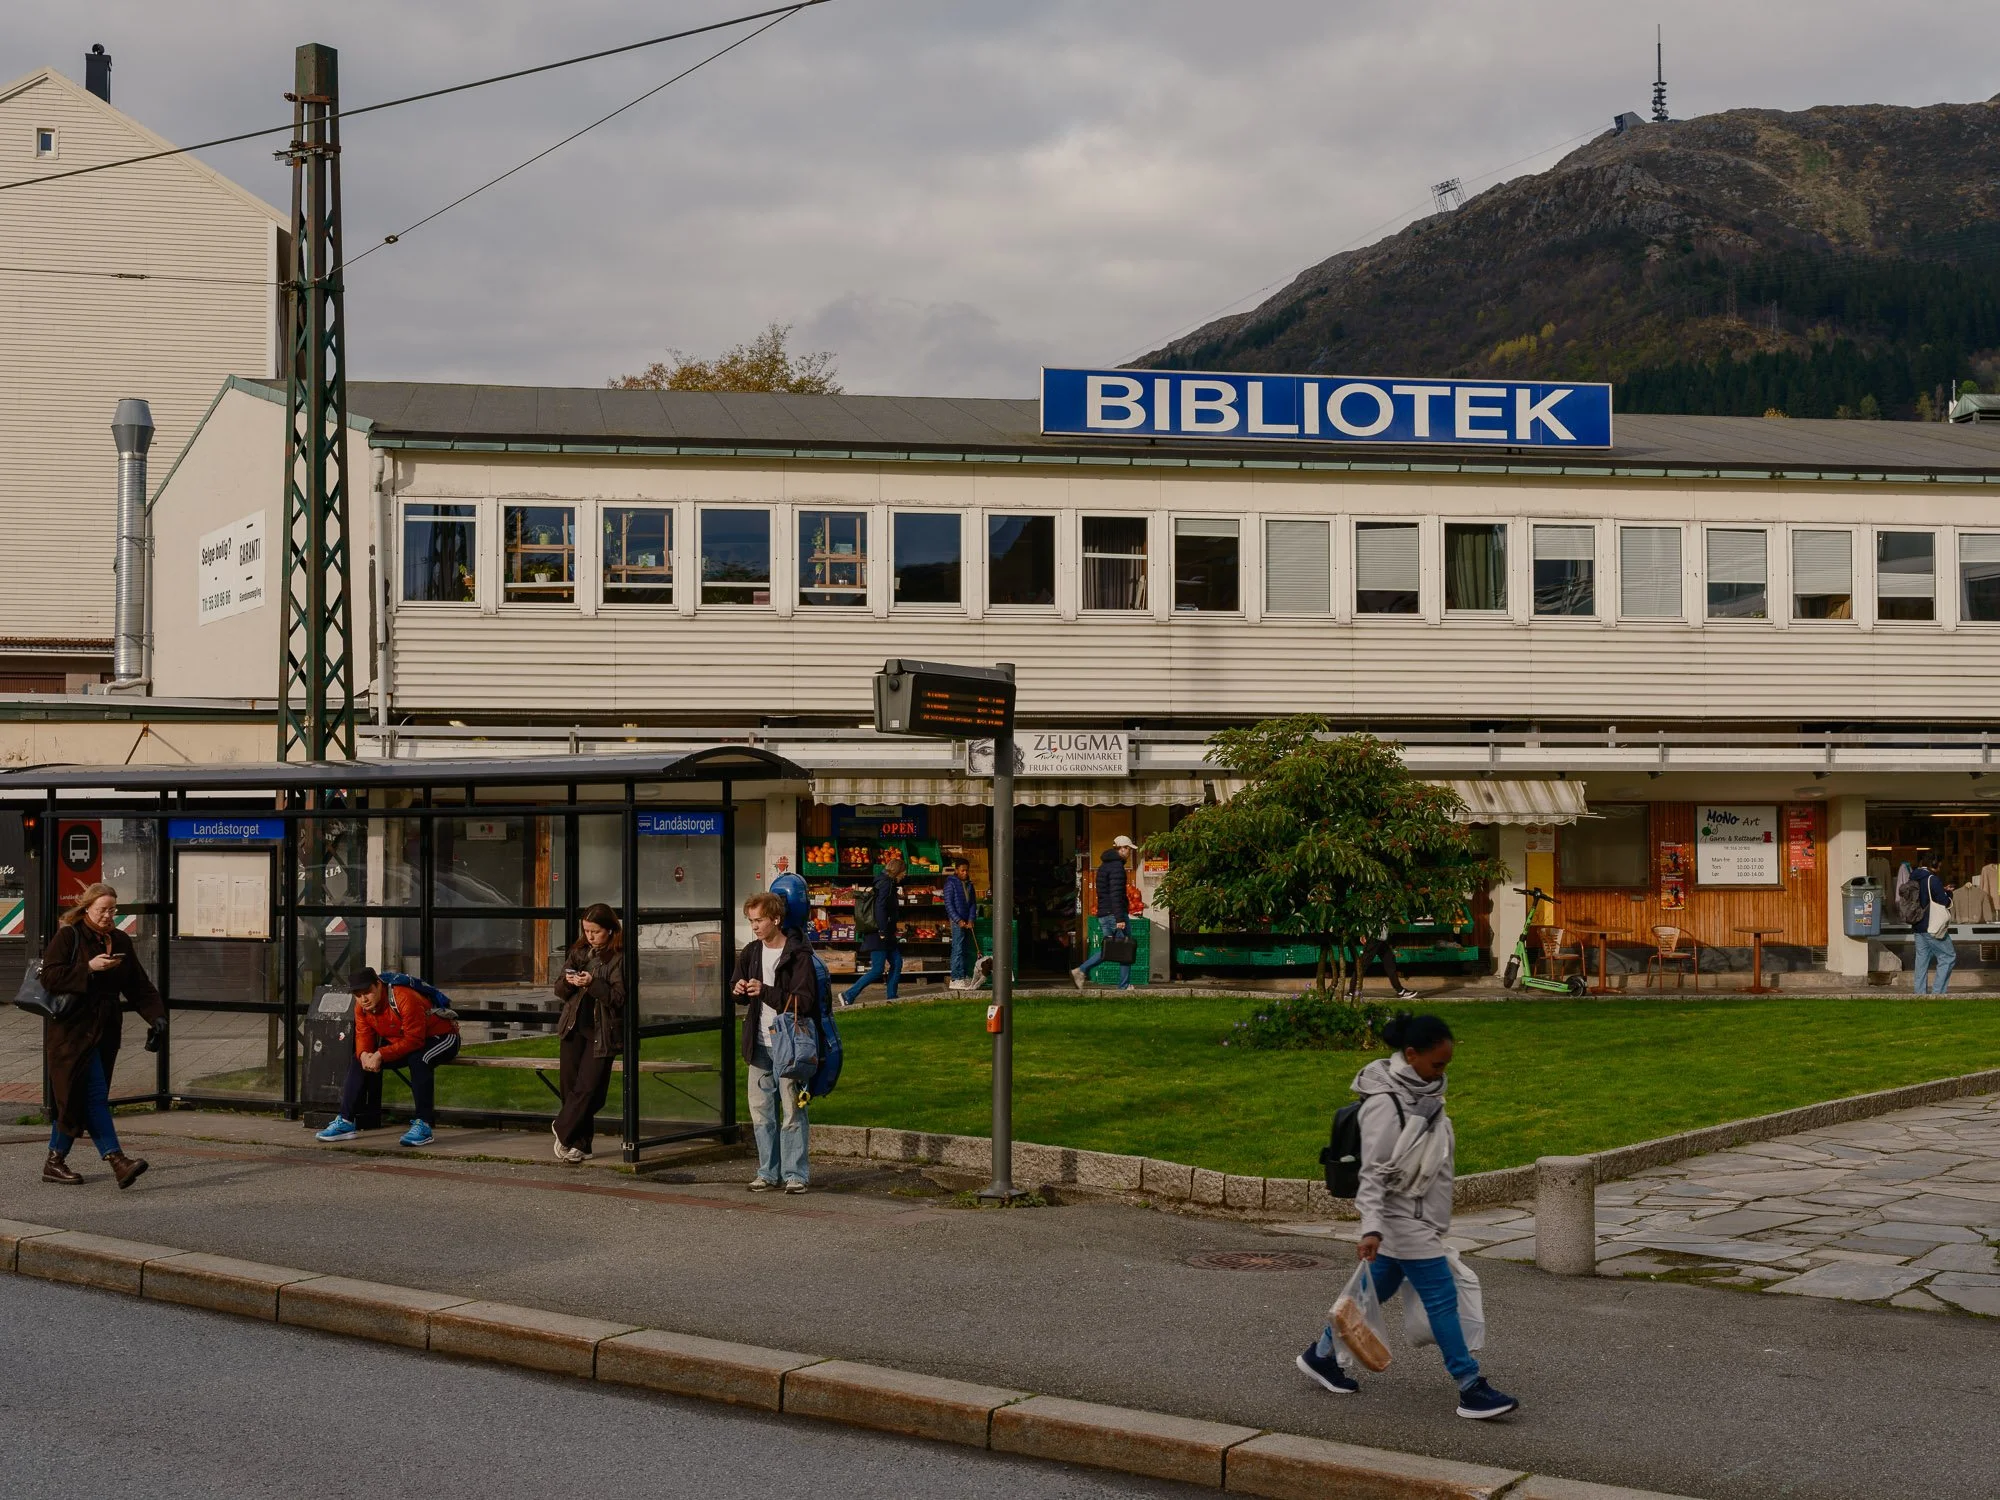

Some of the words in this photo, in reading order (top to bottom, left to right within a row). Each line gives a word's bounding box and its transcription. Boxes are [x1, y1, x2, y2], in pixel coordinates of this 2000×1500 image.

[1085, 375, 1577, 441] BIBLIOTEK
[1034, 734, 1123, 751] ZEUGMA
[1065, 752, 1123, 760] MINIMARKET
[1029, 764, 1053, 772] FRUKT
[1056, 764, 1068, 772] OG
[1069, 764, 1123, 772] GRØNNSAKER
[654, 816, 714, 833] Landåstorget
[882, 822, 915, 834] OPEN
[1742, 817, 1761, 826] Art
[193, 821, 260, 838] Landåstorget
